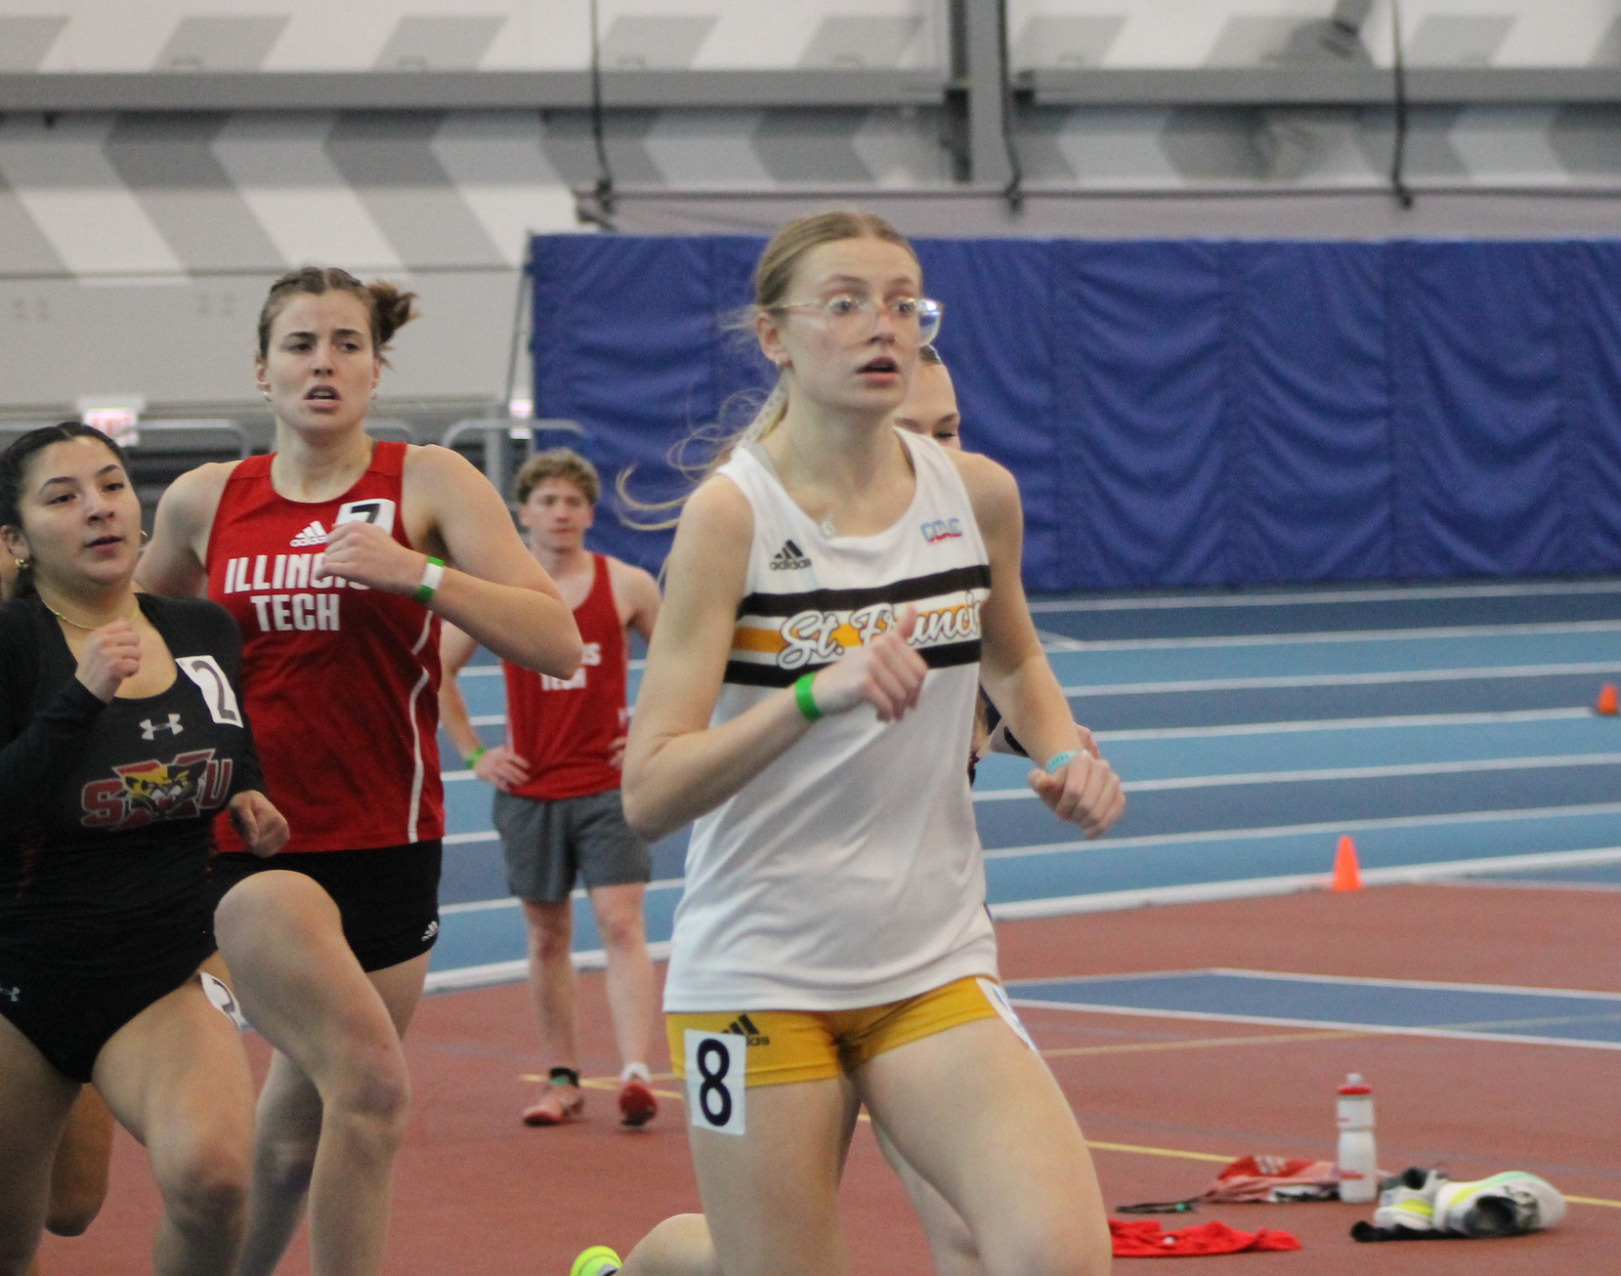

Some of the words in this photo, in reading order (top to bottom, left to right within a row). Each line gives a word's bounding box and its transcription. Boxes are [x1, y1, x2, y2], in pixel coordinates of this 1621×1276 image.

[251, 593, 340, 632] TECH
[776, 609, 845, 670] St.
[191, 660, 238, 721] 2
[697, 1038, 732, 1127] 8
